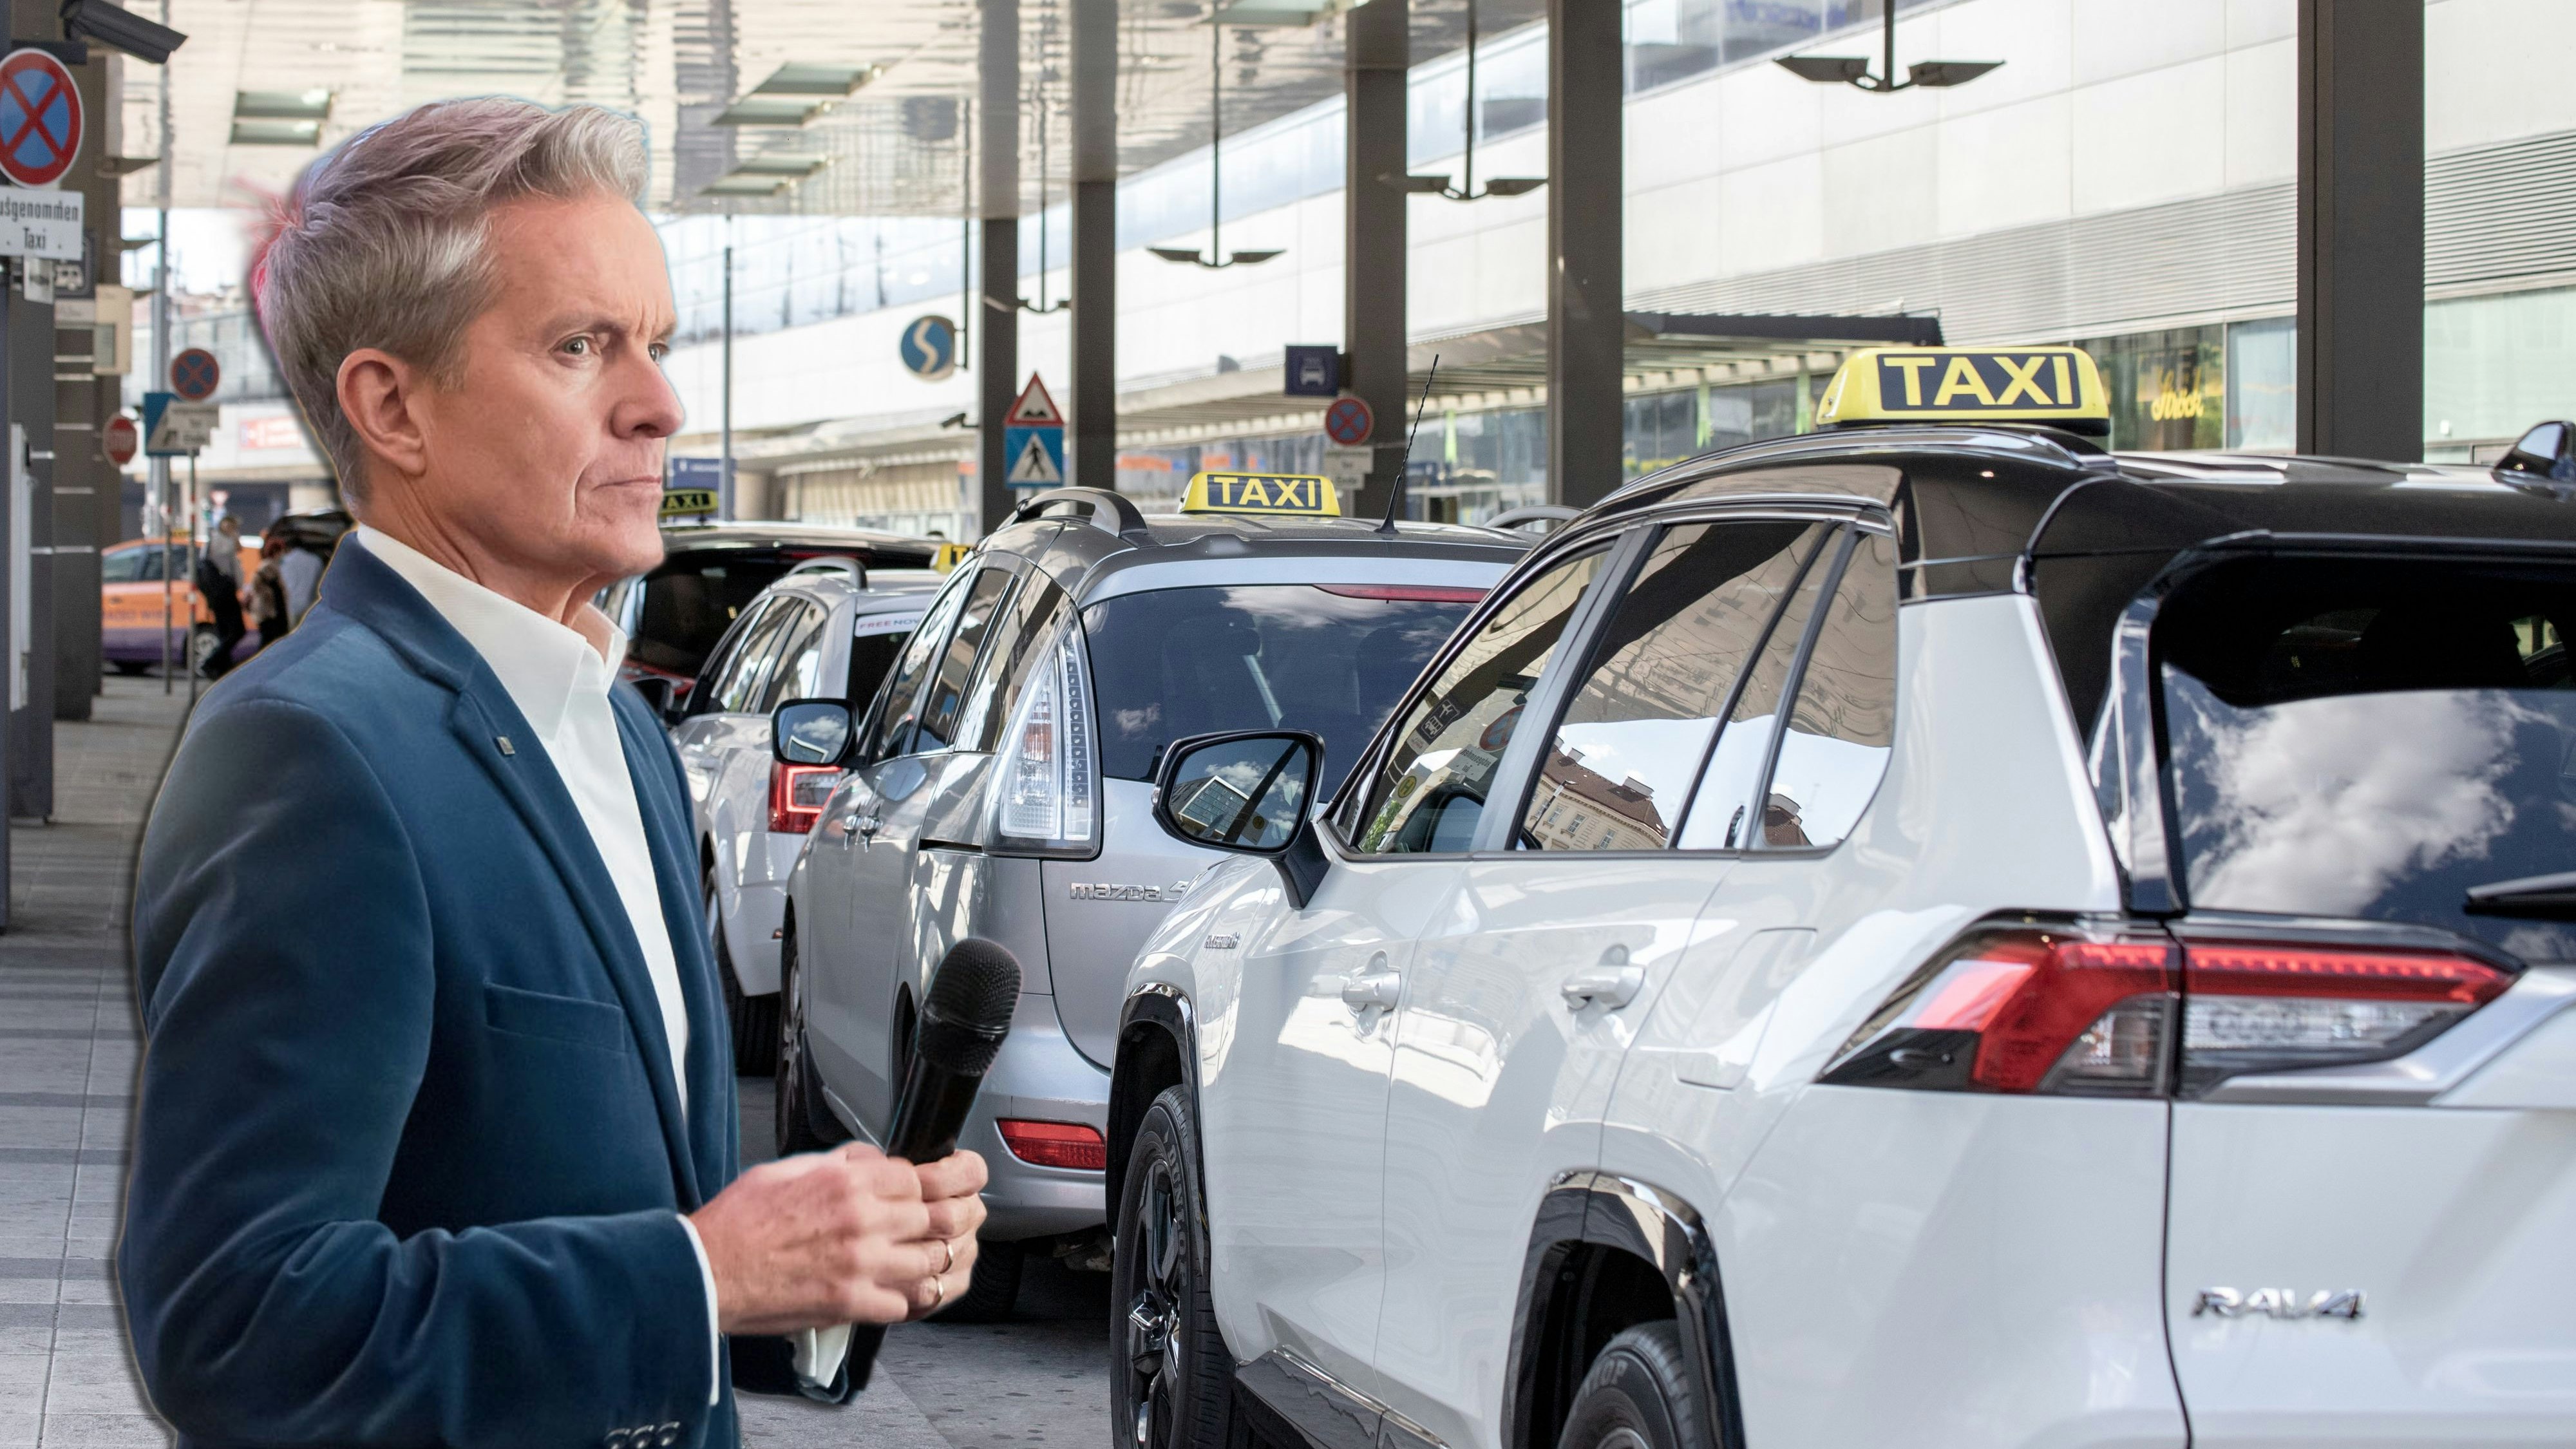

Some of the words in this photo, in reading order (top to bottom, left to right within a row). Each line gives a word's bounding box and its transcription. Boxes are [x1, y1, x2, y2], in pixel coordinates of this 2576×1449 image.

[23, 227, 46, 251] Taxi
[1883, 355, 2073, 406] TAXI
[665, 493, 703, 508] AXI
[1214, 477, 1316, 507] TAXI
[860, 620, 891, 629] FREE
[2191, 1287, 2368, 1319] RAV4
